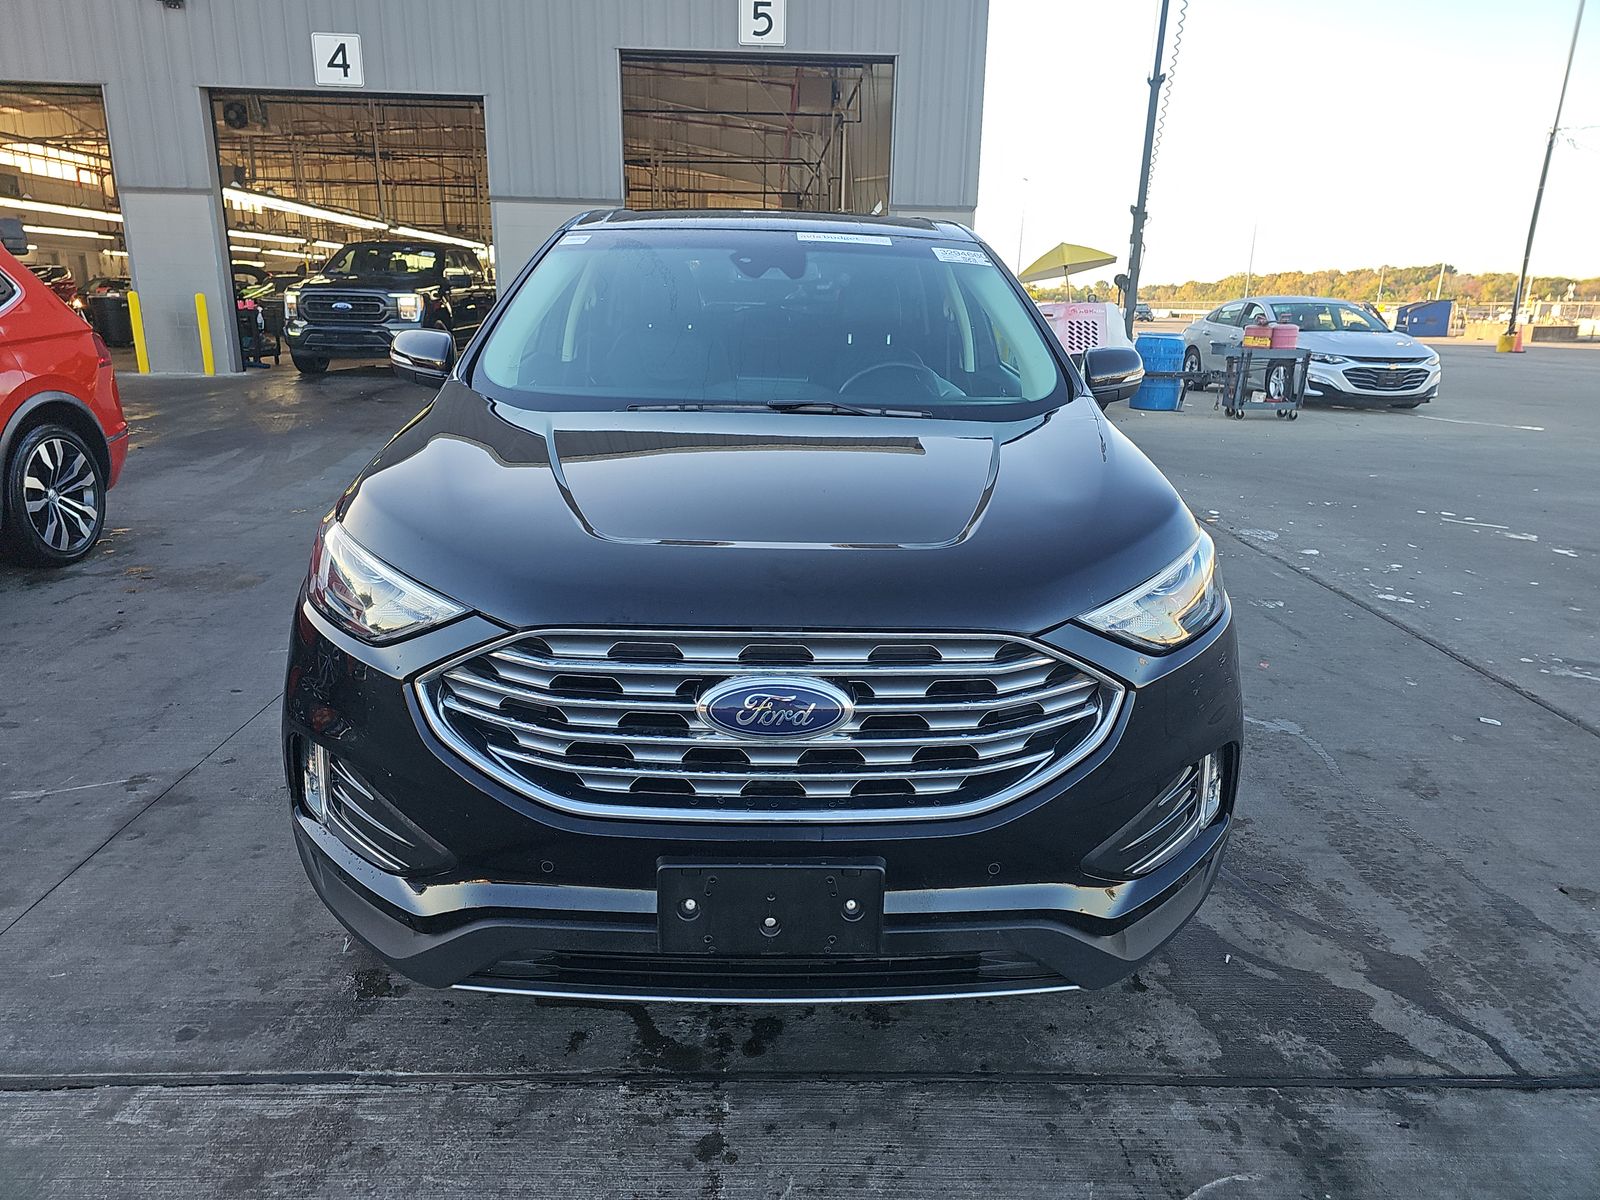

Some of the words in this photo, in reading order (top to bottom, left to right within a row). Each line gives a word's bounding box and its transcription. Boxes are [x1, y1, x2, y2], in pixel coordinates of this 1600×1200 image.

[752, 1, 773, 37] 5
[327, 42, 351, 78] 4
[735, 693, 817, 726] Ford
